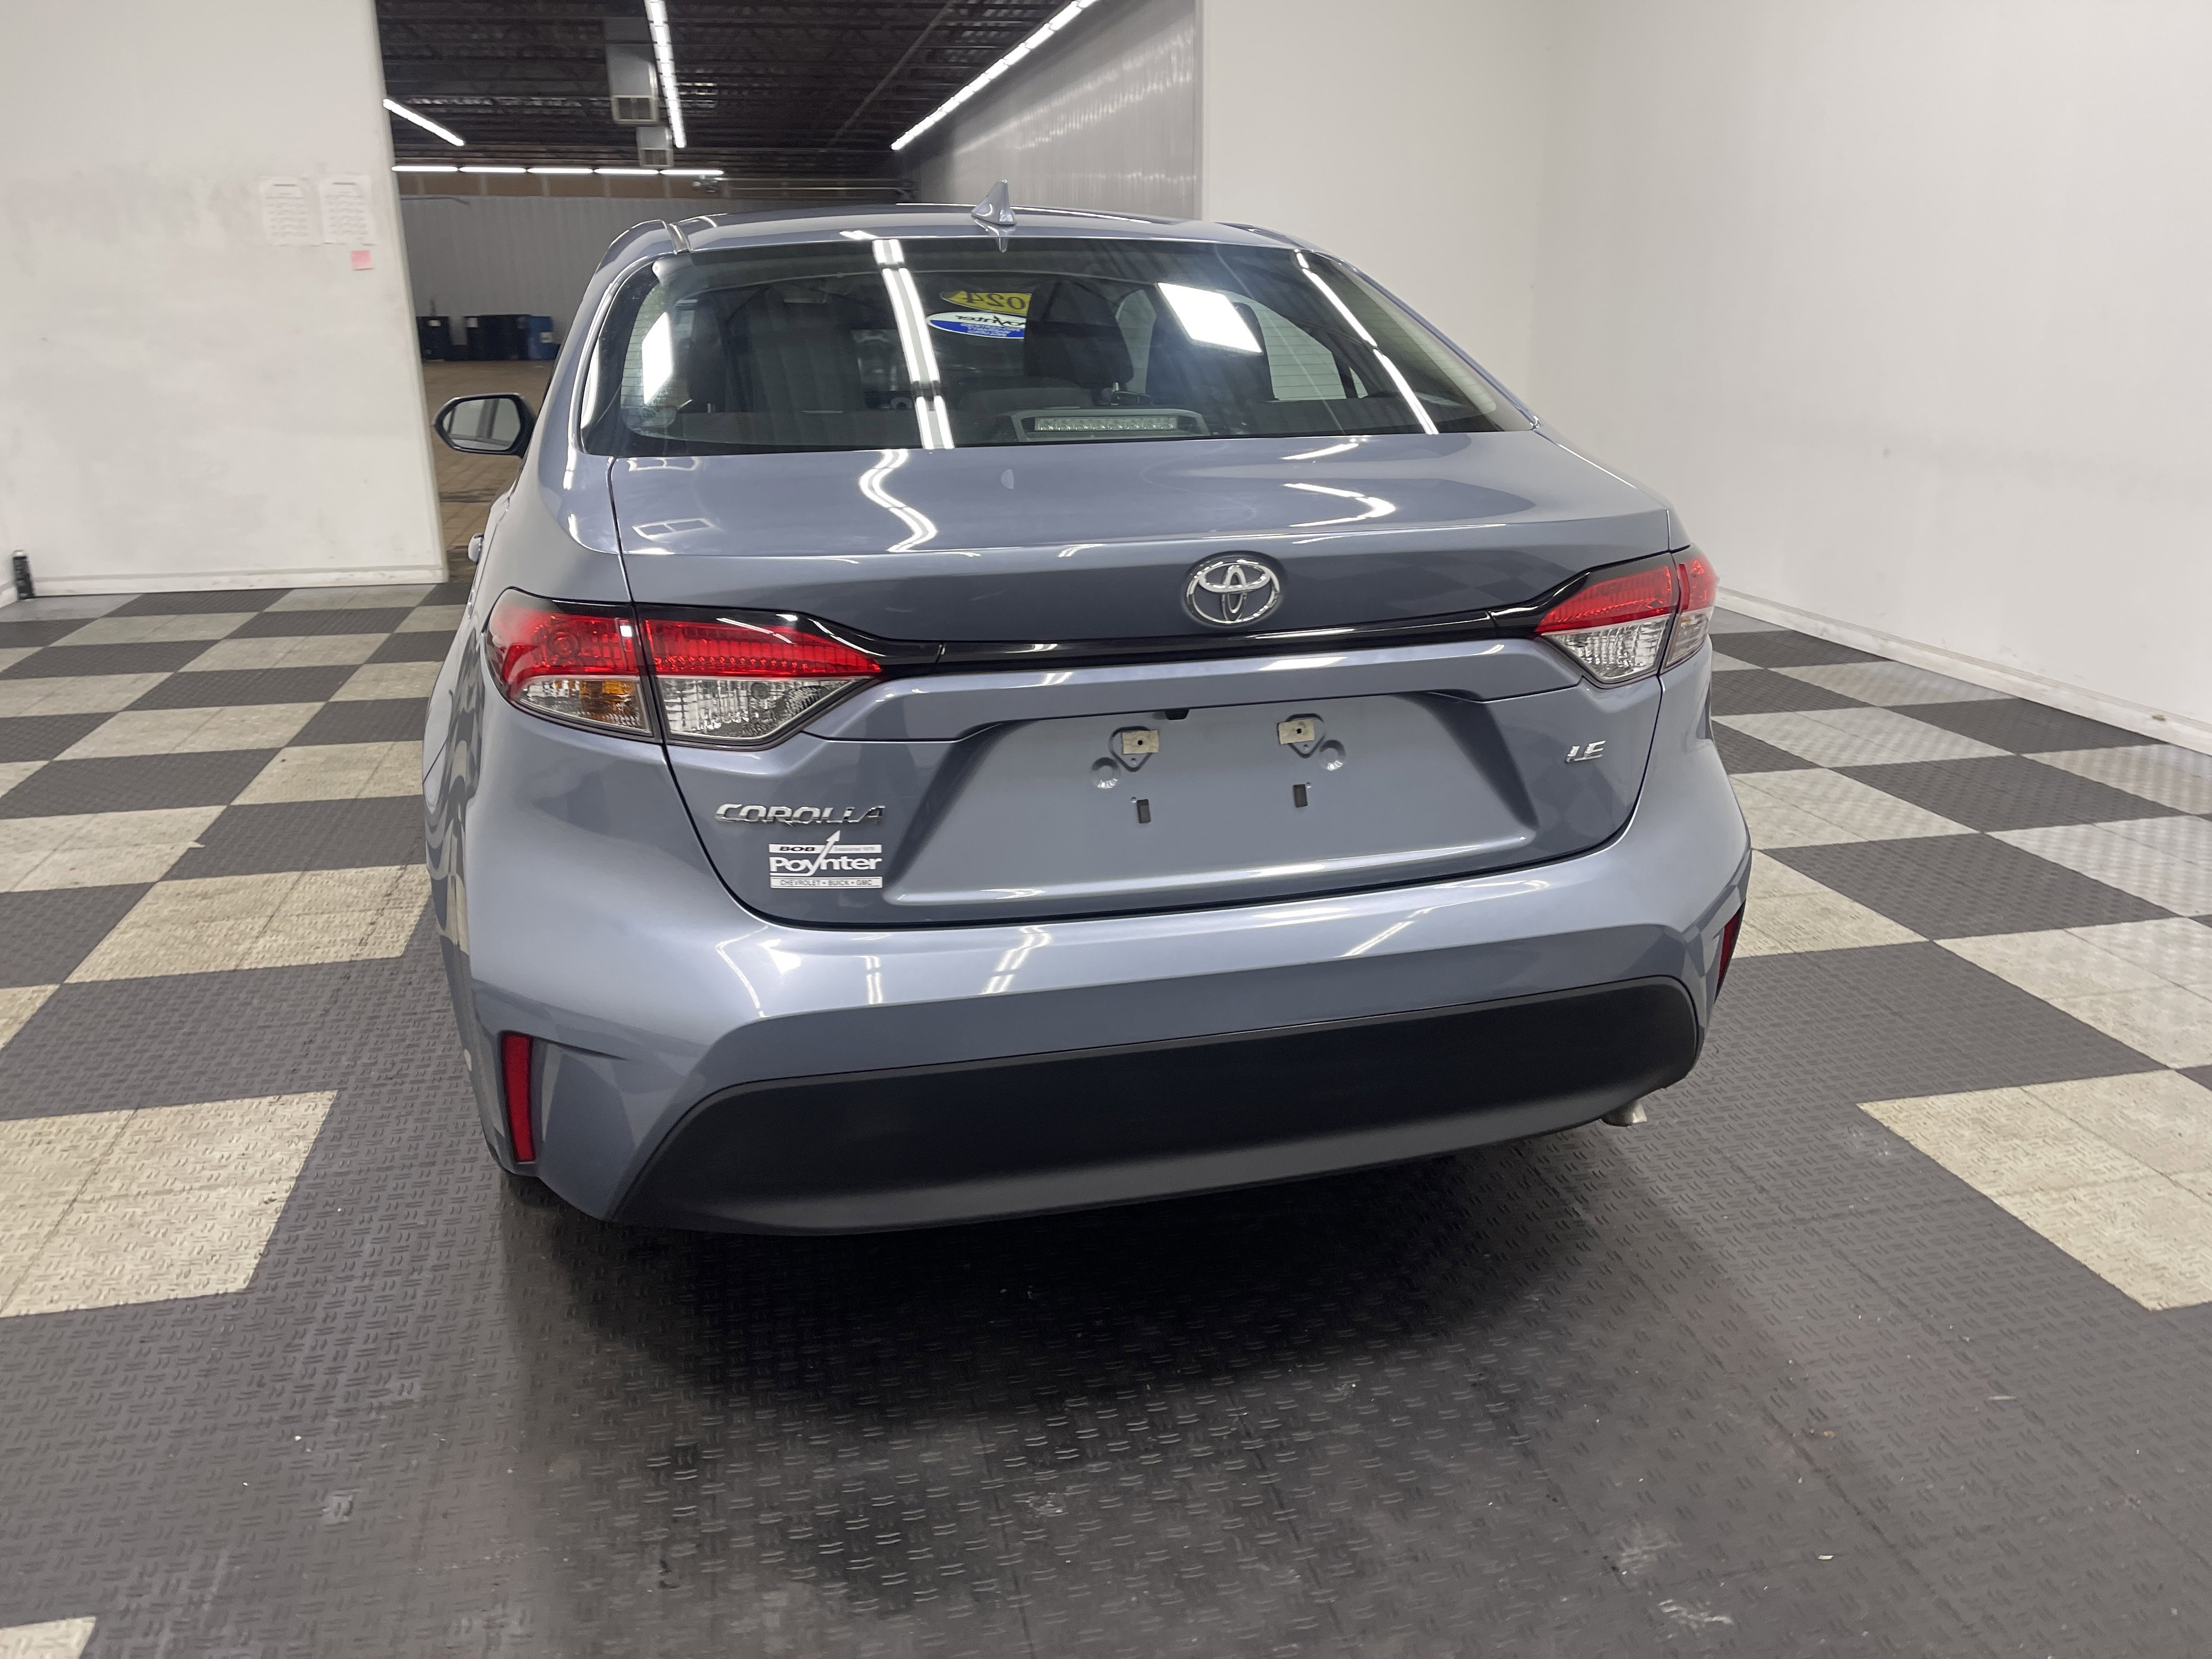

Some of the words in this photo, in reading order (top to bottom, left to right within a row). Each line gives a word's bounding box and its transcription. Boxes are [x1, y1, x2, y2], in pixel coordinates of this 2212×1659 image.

[1566, 740, 1606, 763] LE
[715, 804, 885, 827] COROLLA
[769, 856, 882, 874] Poynter
